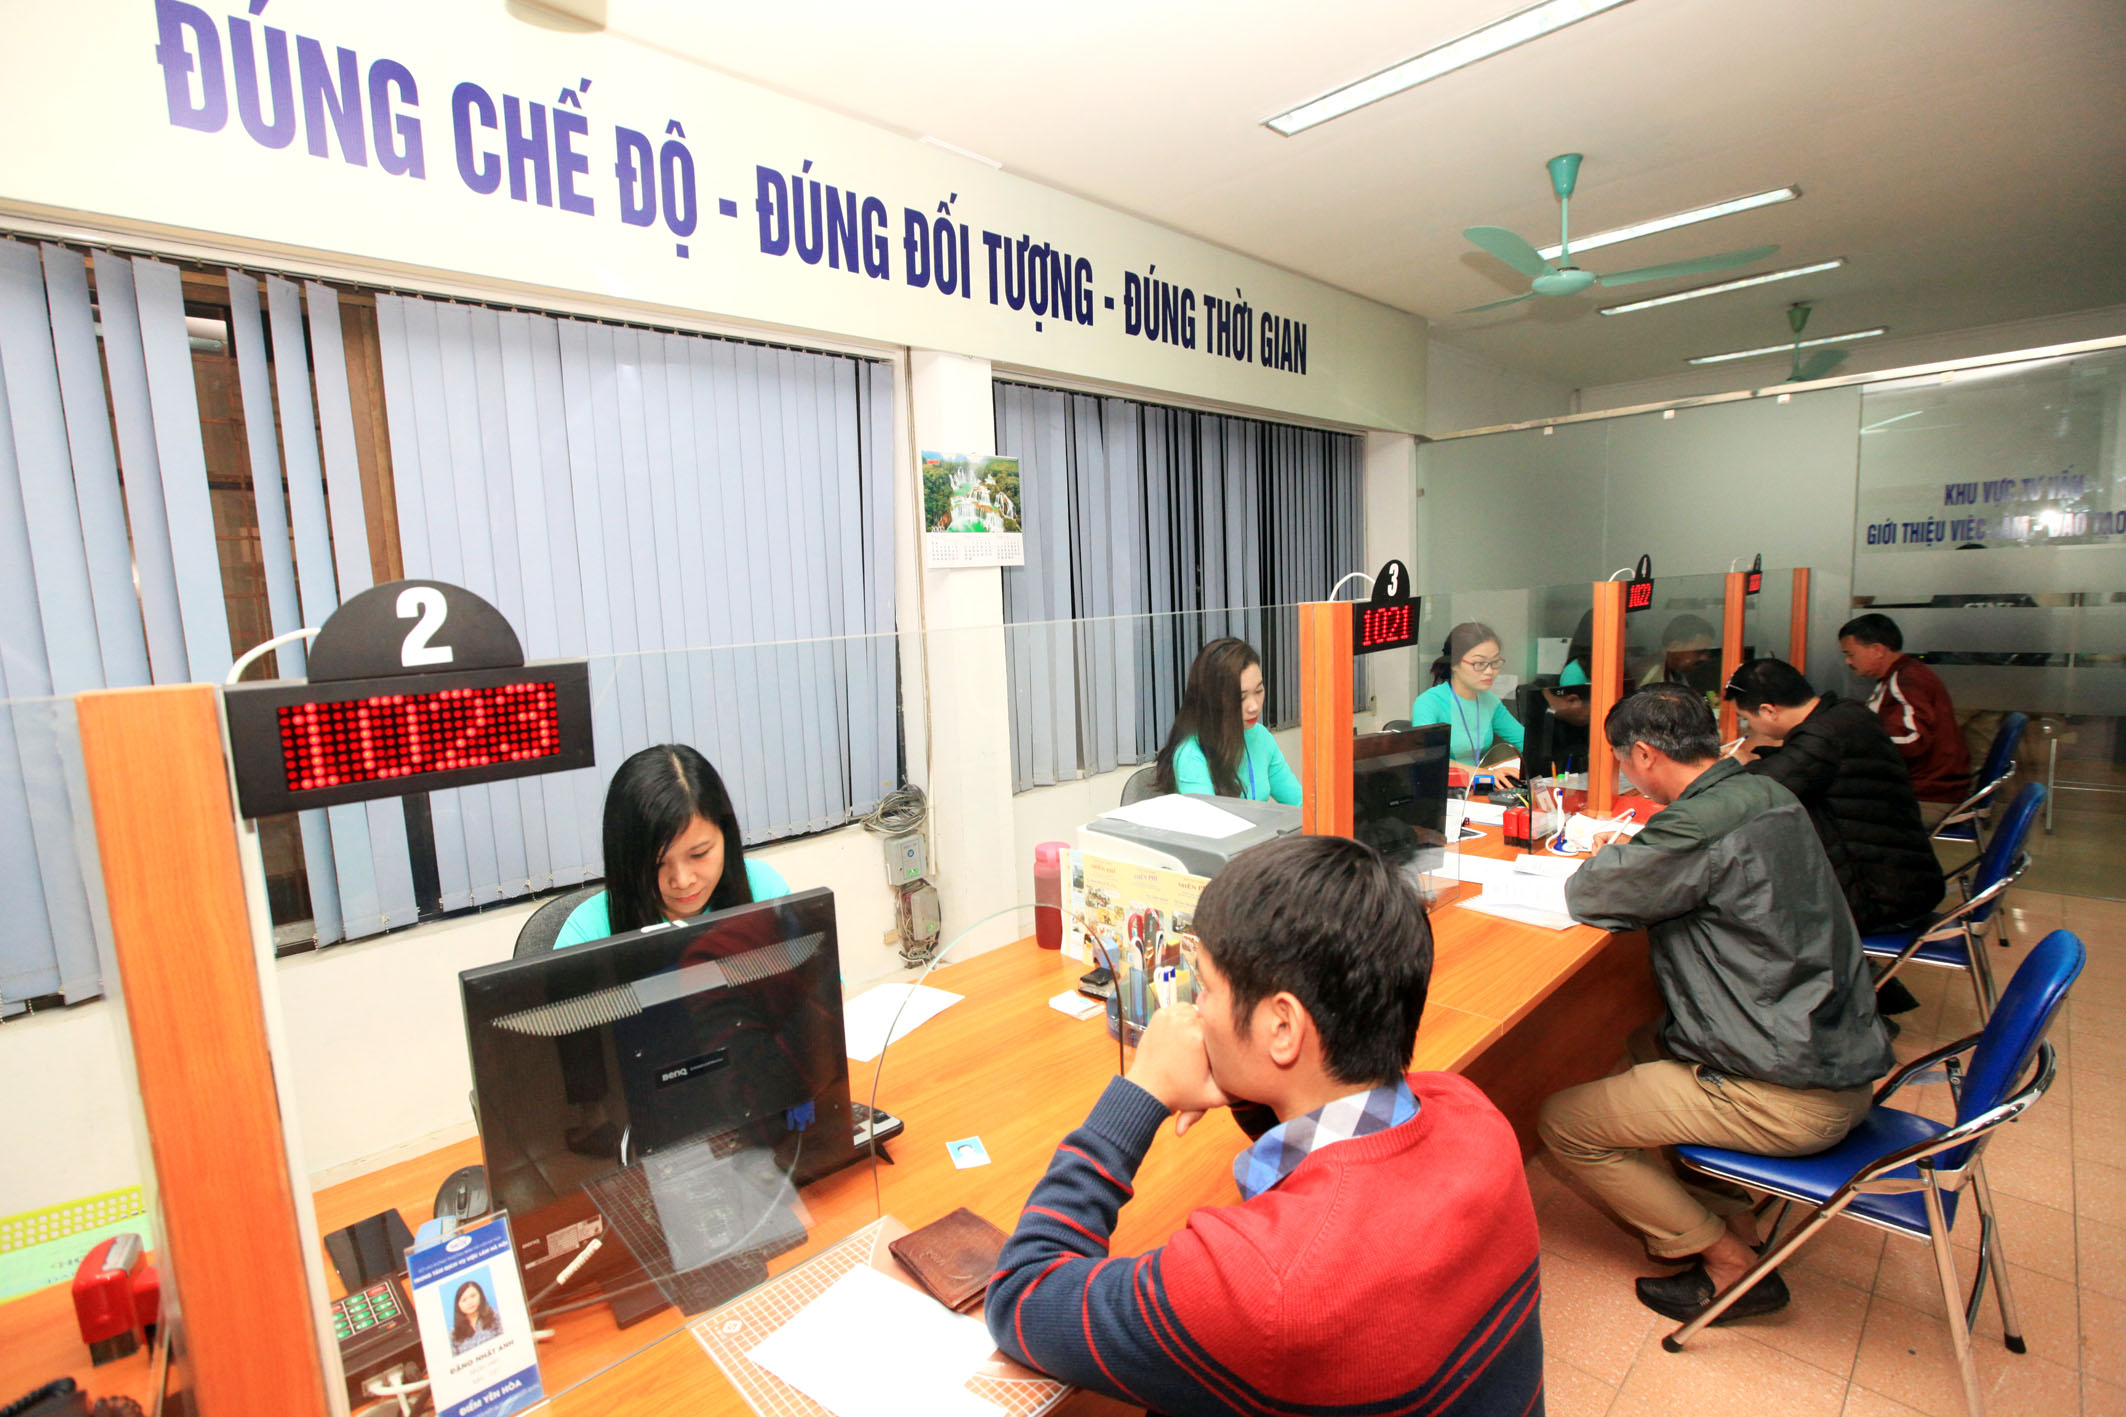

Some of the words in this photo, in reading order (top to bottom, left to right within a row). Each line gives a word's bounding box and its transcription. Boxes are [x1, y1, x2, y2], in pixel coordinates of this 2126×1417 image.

[155, 0, 425, 180] ĐÚNG
[451, 77, 596, 217] CHẾ
[614, 119, 698, 259] ĐỘ
[719, 197, 738, 218] -
[756, 159, 890, 281] ĐÚNG
[903, 192, 971, 299] ĐỐI
[982, 232, 1094, 332] TƯỢNG
[1123, 264, 1196, 350] ĐÚNG
[1203, 288, 1254, 364] THỜI
[1260, 310, 1308, 376] GIAN
[1944, 482, 1978, 506] KHU
[1867, 518, 1897, 545] GIỚI
[1902, 516, 1946, 547] THIỆU
[1387, 563, 1399, 596] 3
[396, 586, 454, 667] 2
[1362, 605, 1410, 646] 1021
[292, 682, 551, 790] 1023
